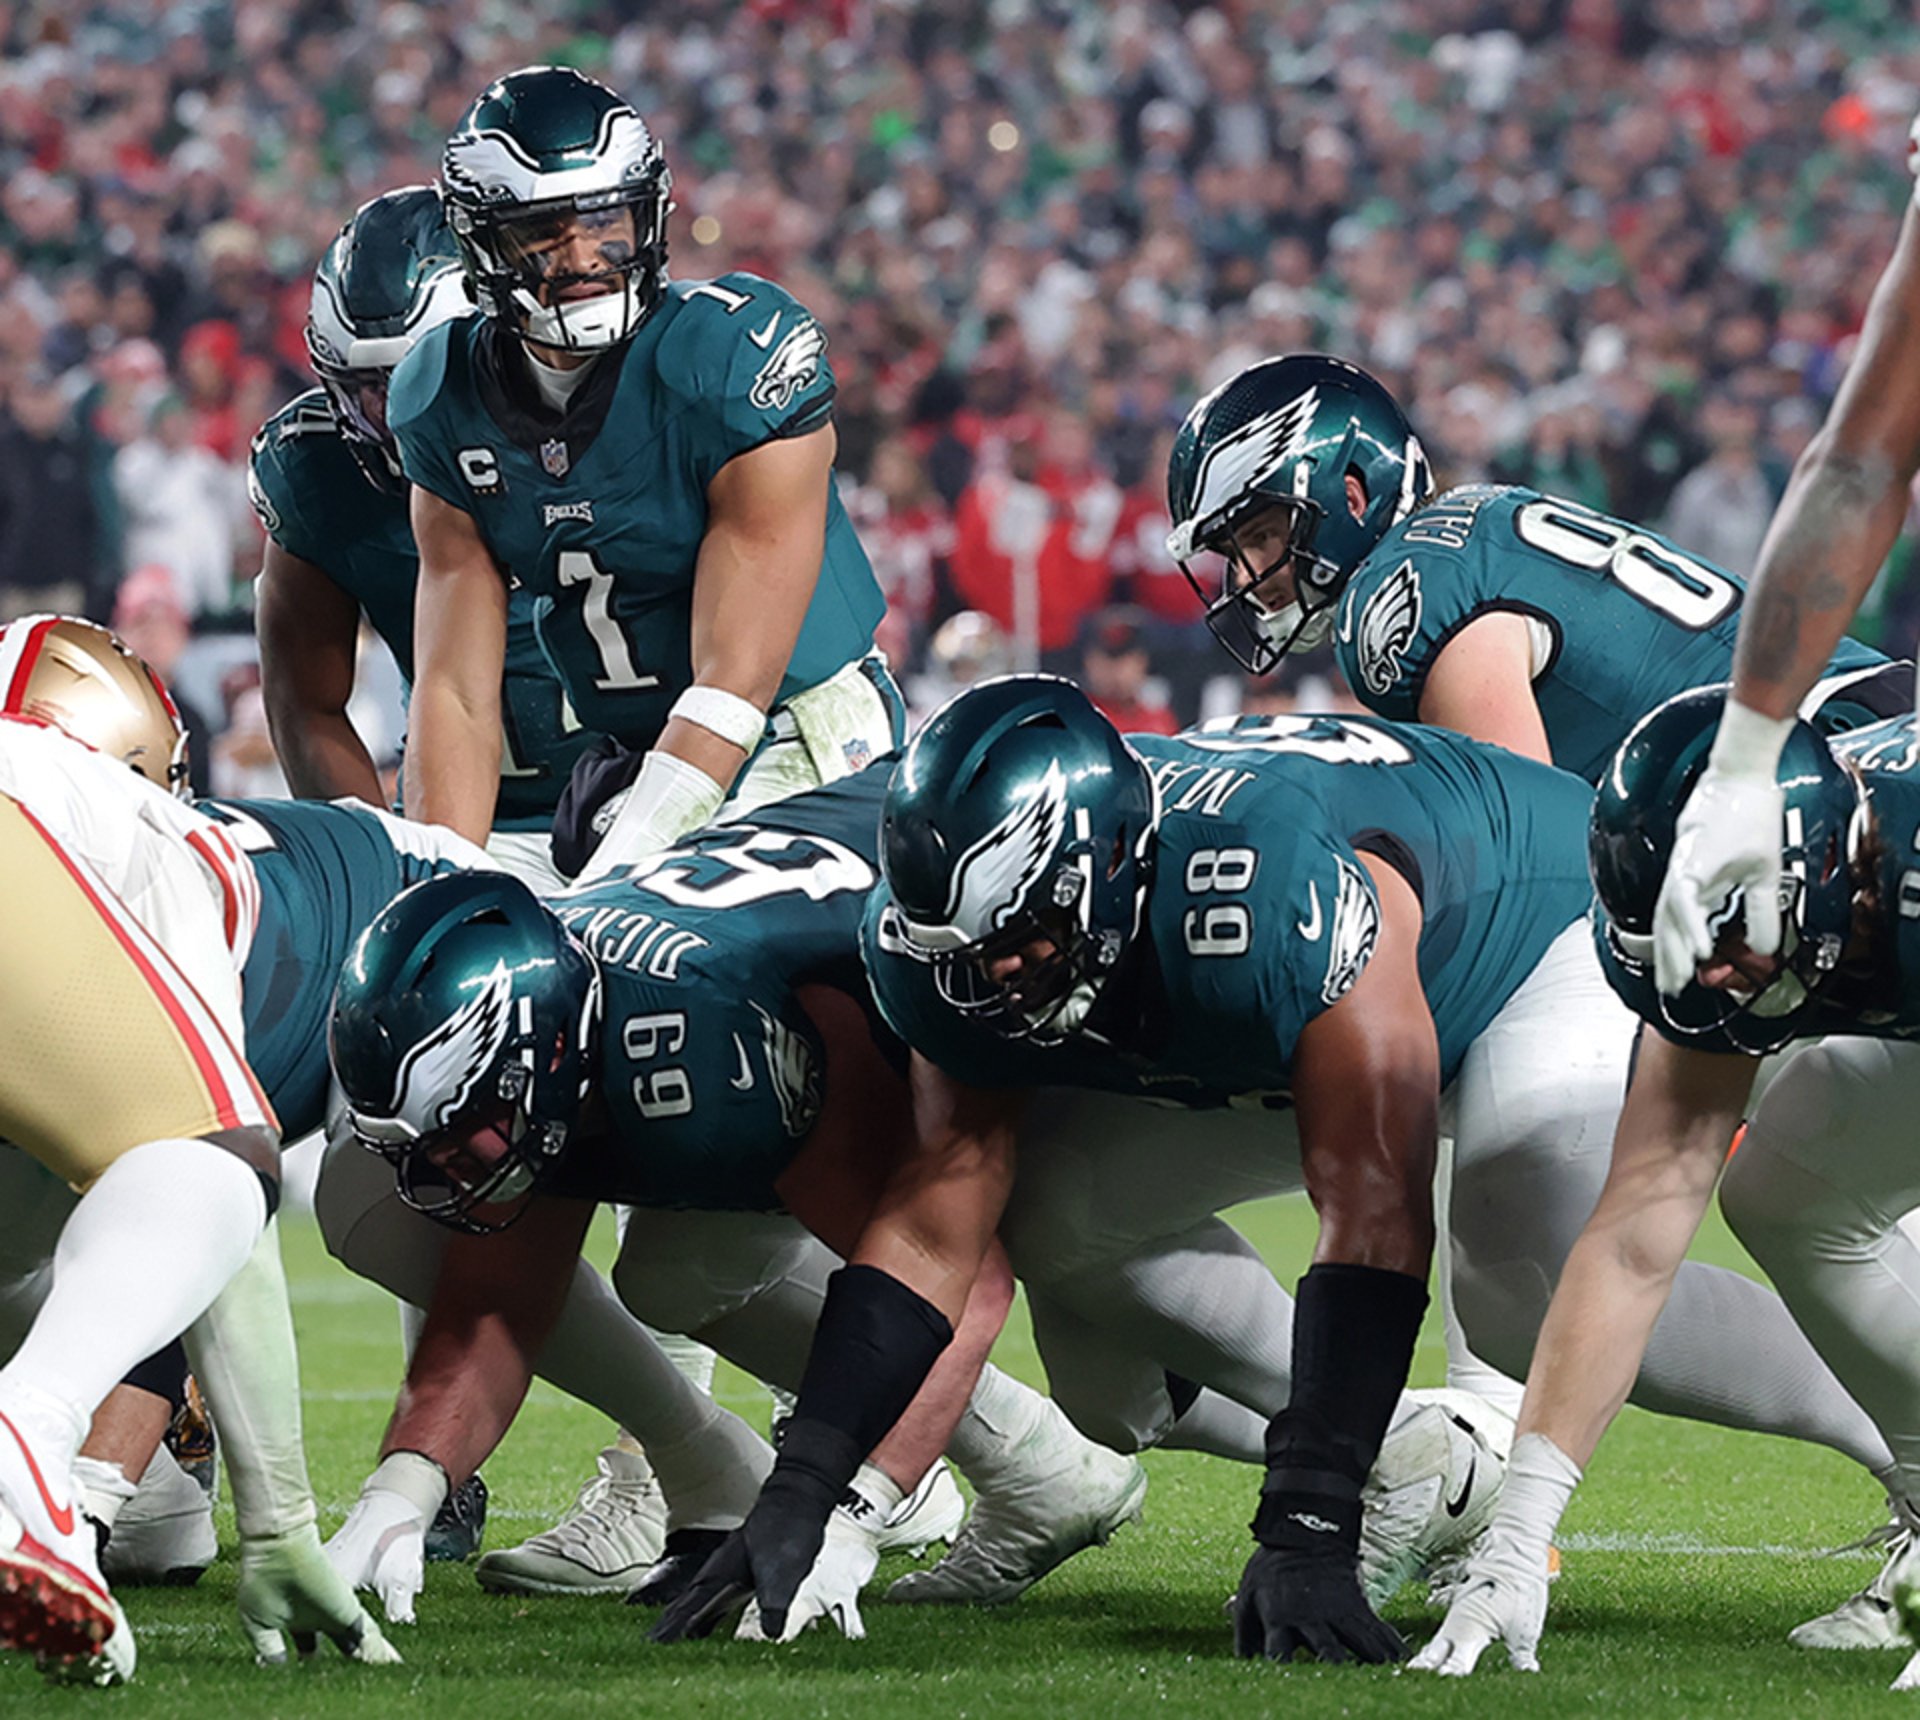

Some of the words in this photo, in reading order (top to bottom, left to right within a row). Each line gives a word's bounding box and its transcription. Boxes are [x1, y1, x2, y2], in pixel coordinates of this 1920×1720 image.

[681, 285, 752, 312] 1
[458, 448, 499, 487] C
[558, 551, 660, 689] 1
[546, 907, 711, 981] DICK
[1184, 848, 1256, 957] 68
[623, 1011, 693, 1120] 69
